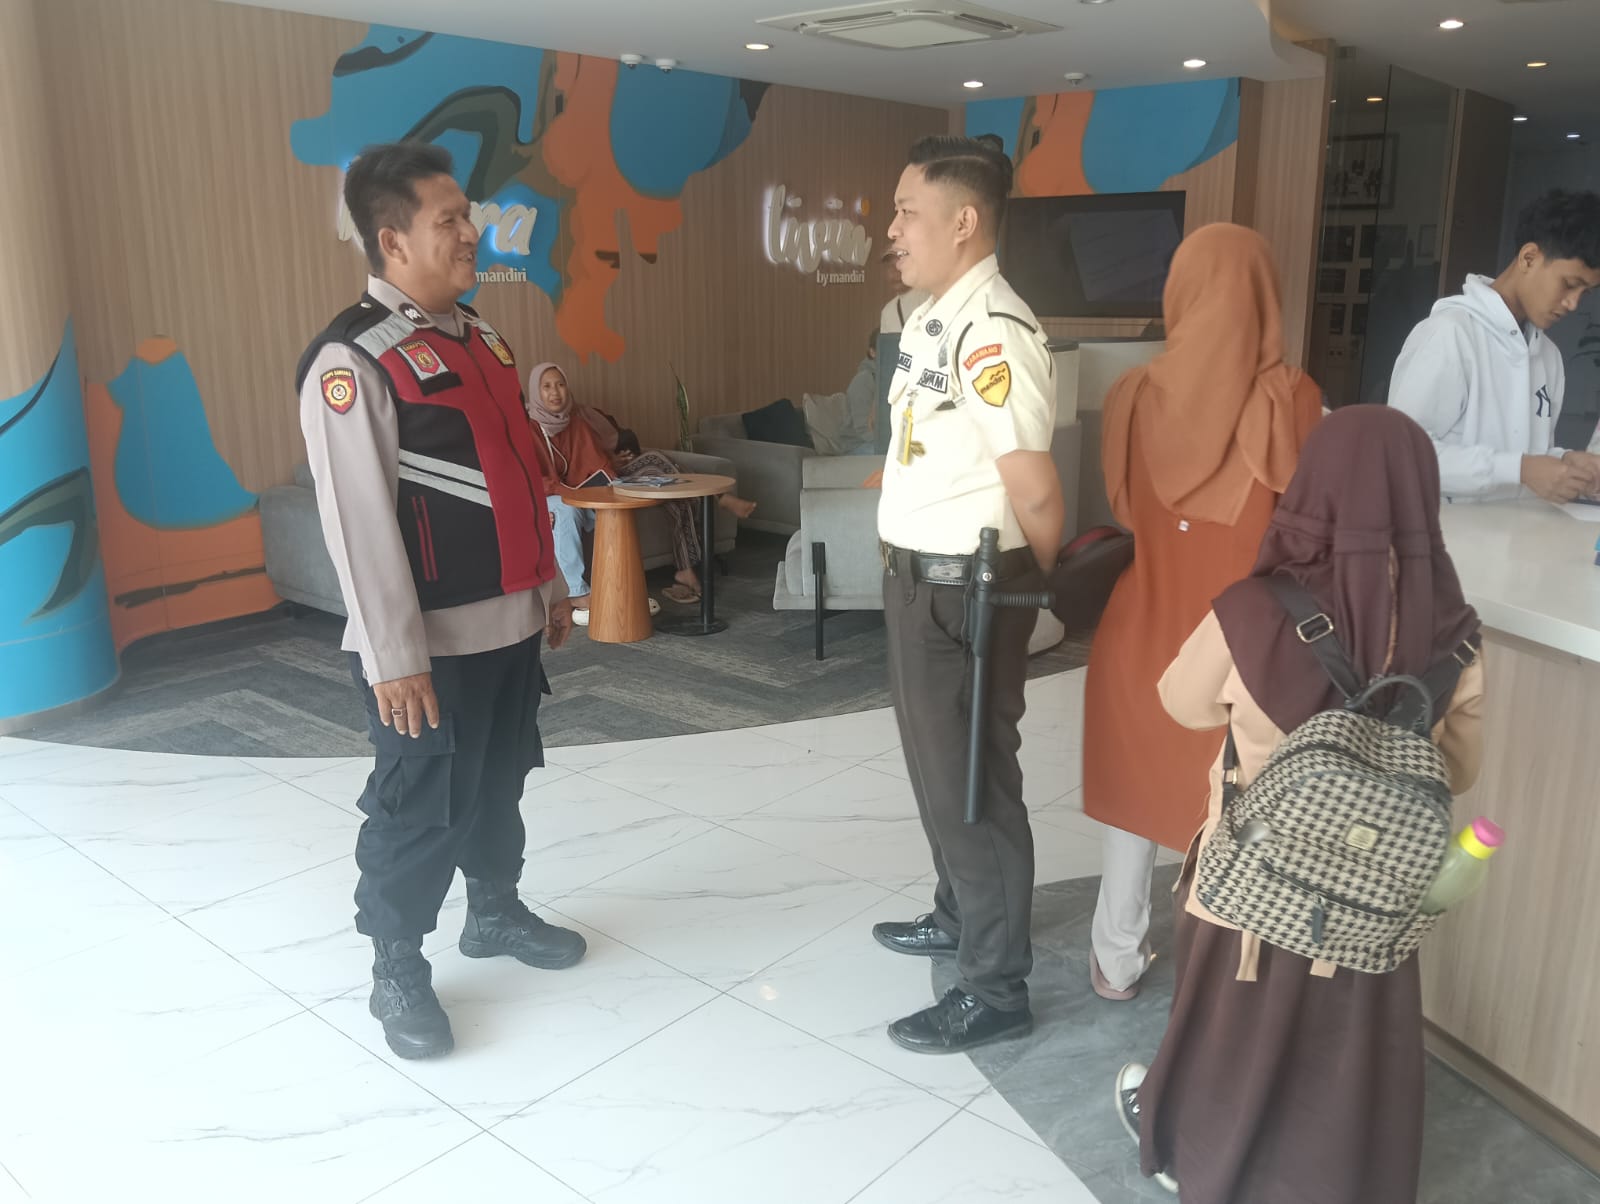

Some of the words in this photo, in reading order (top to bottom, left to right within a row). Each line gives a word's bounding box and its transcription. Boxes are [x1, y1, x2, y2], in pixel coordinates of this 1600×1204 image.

[475, 267, 527, 283] mandiri
[816, 269, 829, 287] by
[829, 269, 865, 283] mandiri
